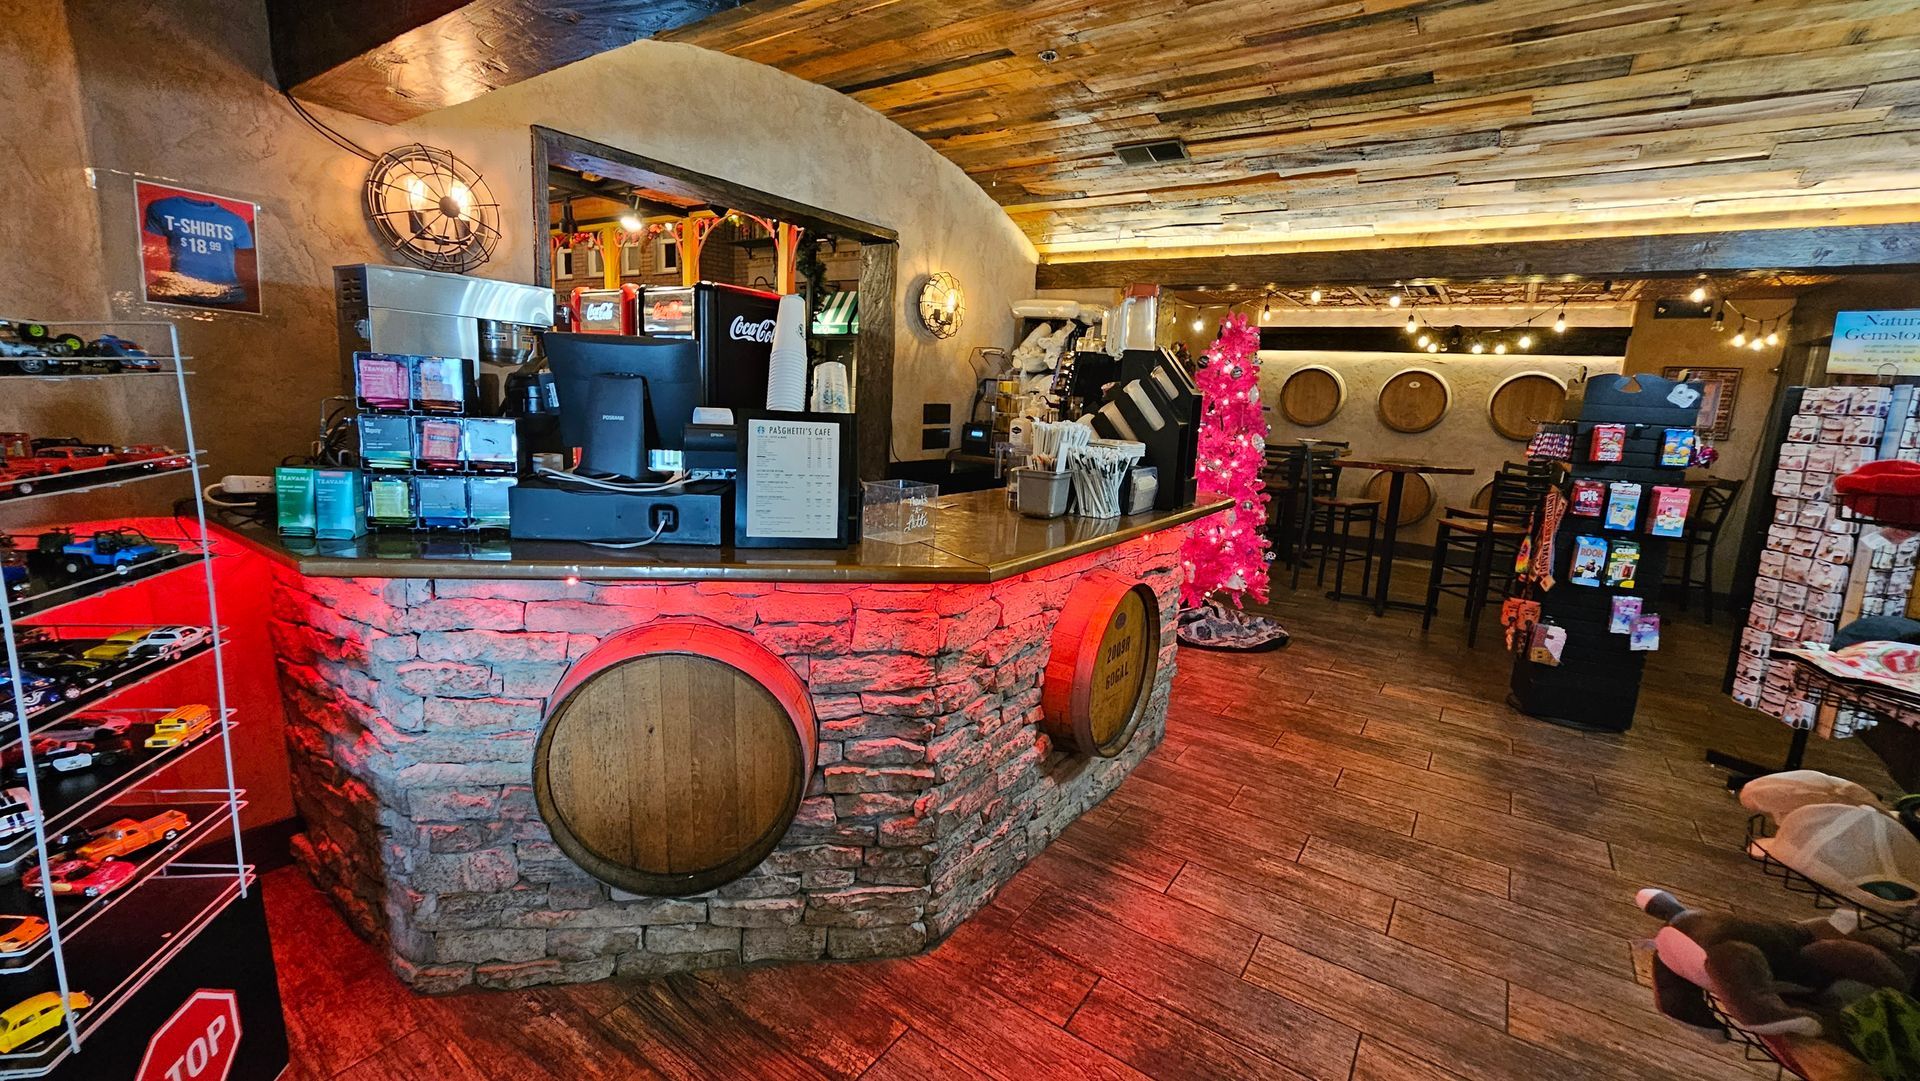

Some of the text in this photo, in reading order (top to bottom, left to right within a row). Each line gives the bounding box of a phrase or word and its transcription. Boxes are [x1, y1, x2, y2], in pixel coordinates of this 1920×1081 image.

[164, 215, 234, 241] T-SHIRTS
[729, 315, 776, 344] Coca-Col
[814, 427, 831, 437] CAFE
[1580, 548, 1604, 558] ROOK
[164, 1014, 226, 1081] TOP
